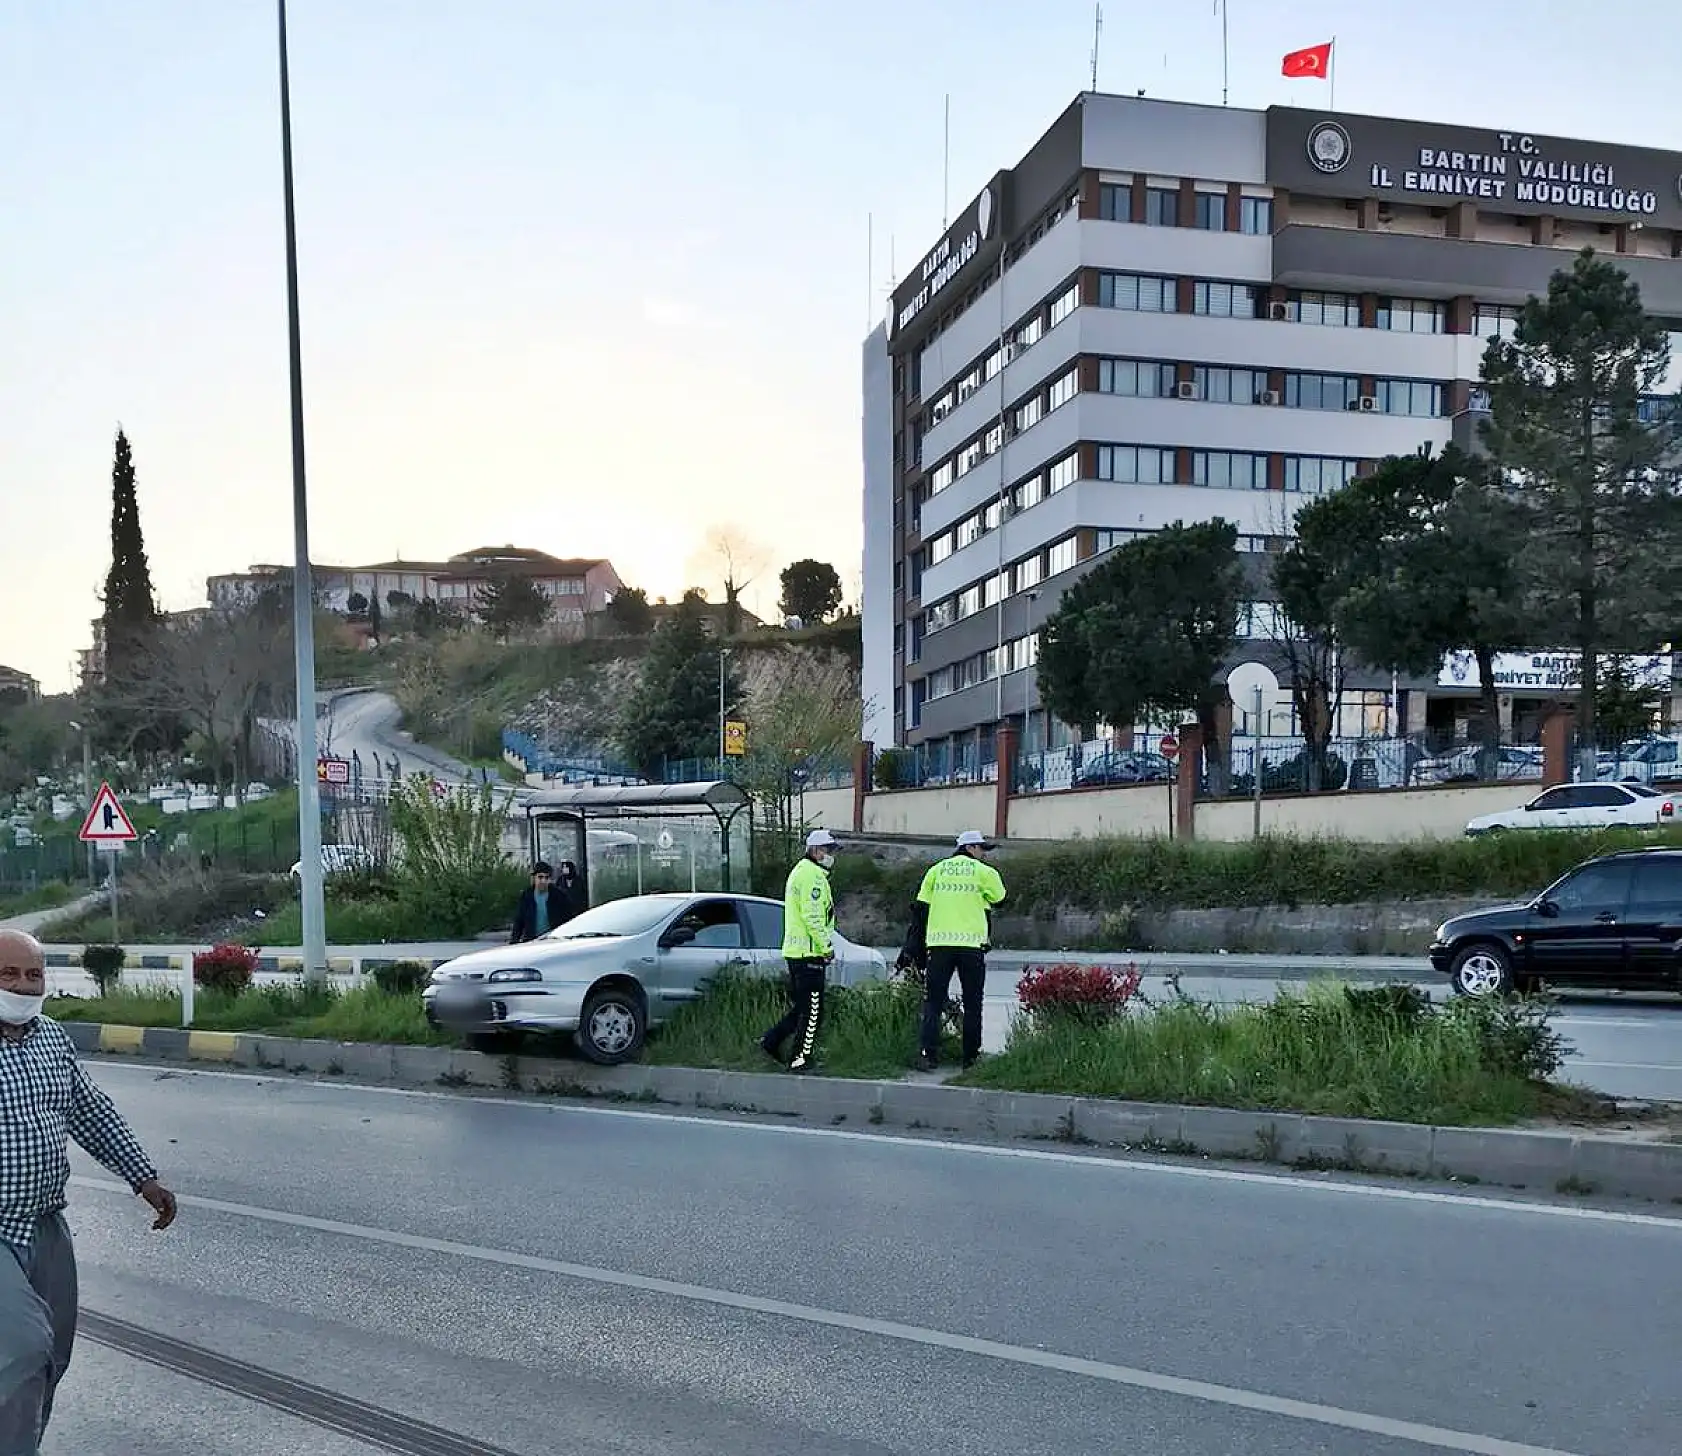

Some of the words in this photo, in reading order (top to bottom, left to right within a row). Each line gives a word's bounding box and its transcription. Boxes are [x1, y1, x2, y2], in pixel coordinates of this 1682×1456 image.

[1499, 133, 1540, 155] T.C.
[1419, 148, 1507, 175] BARTIN
[1518, 158, 1614, 186] VALİLİĞİ
[1371, 163, 1393, 187] İL
[1405, 171, 1506, 198] EMNİYET
[1516, 180, 1656, 213] MÜDÜRLÜĞÜ
